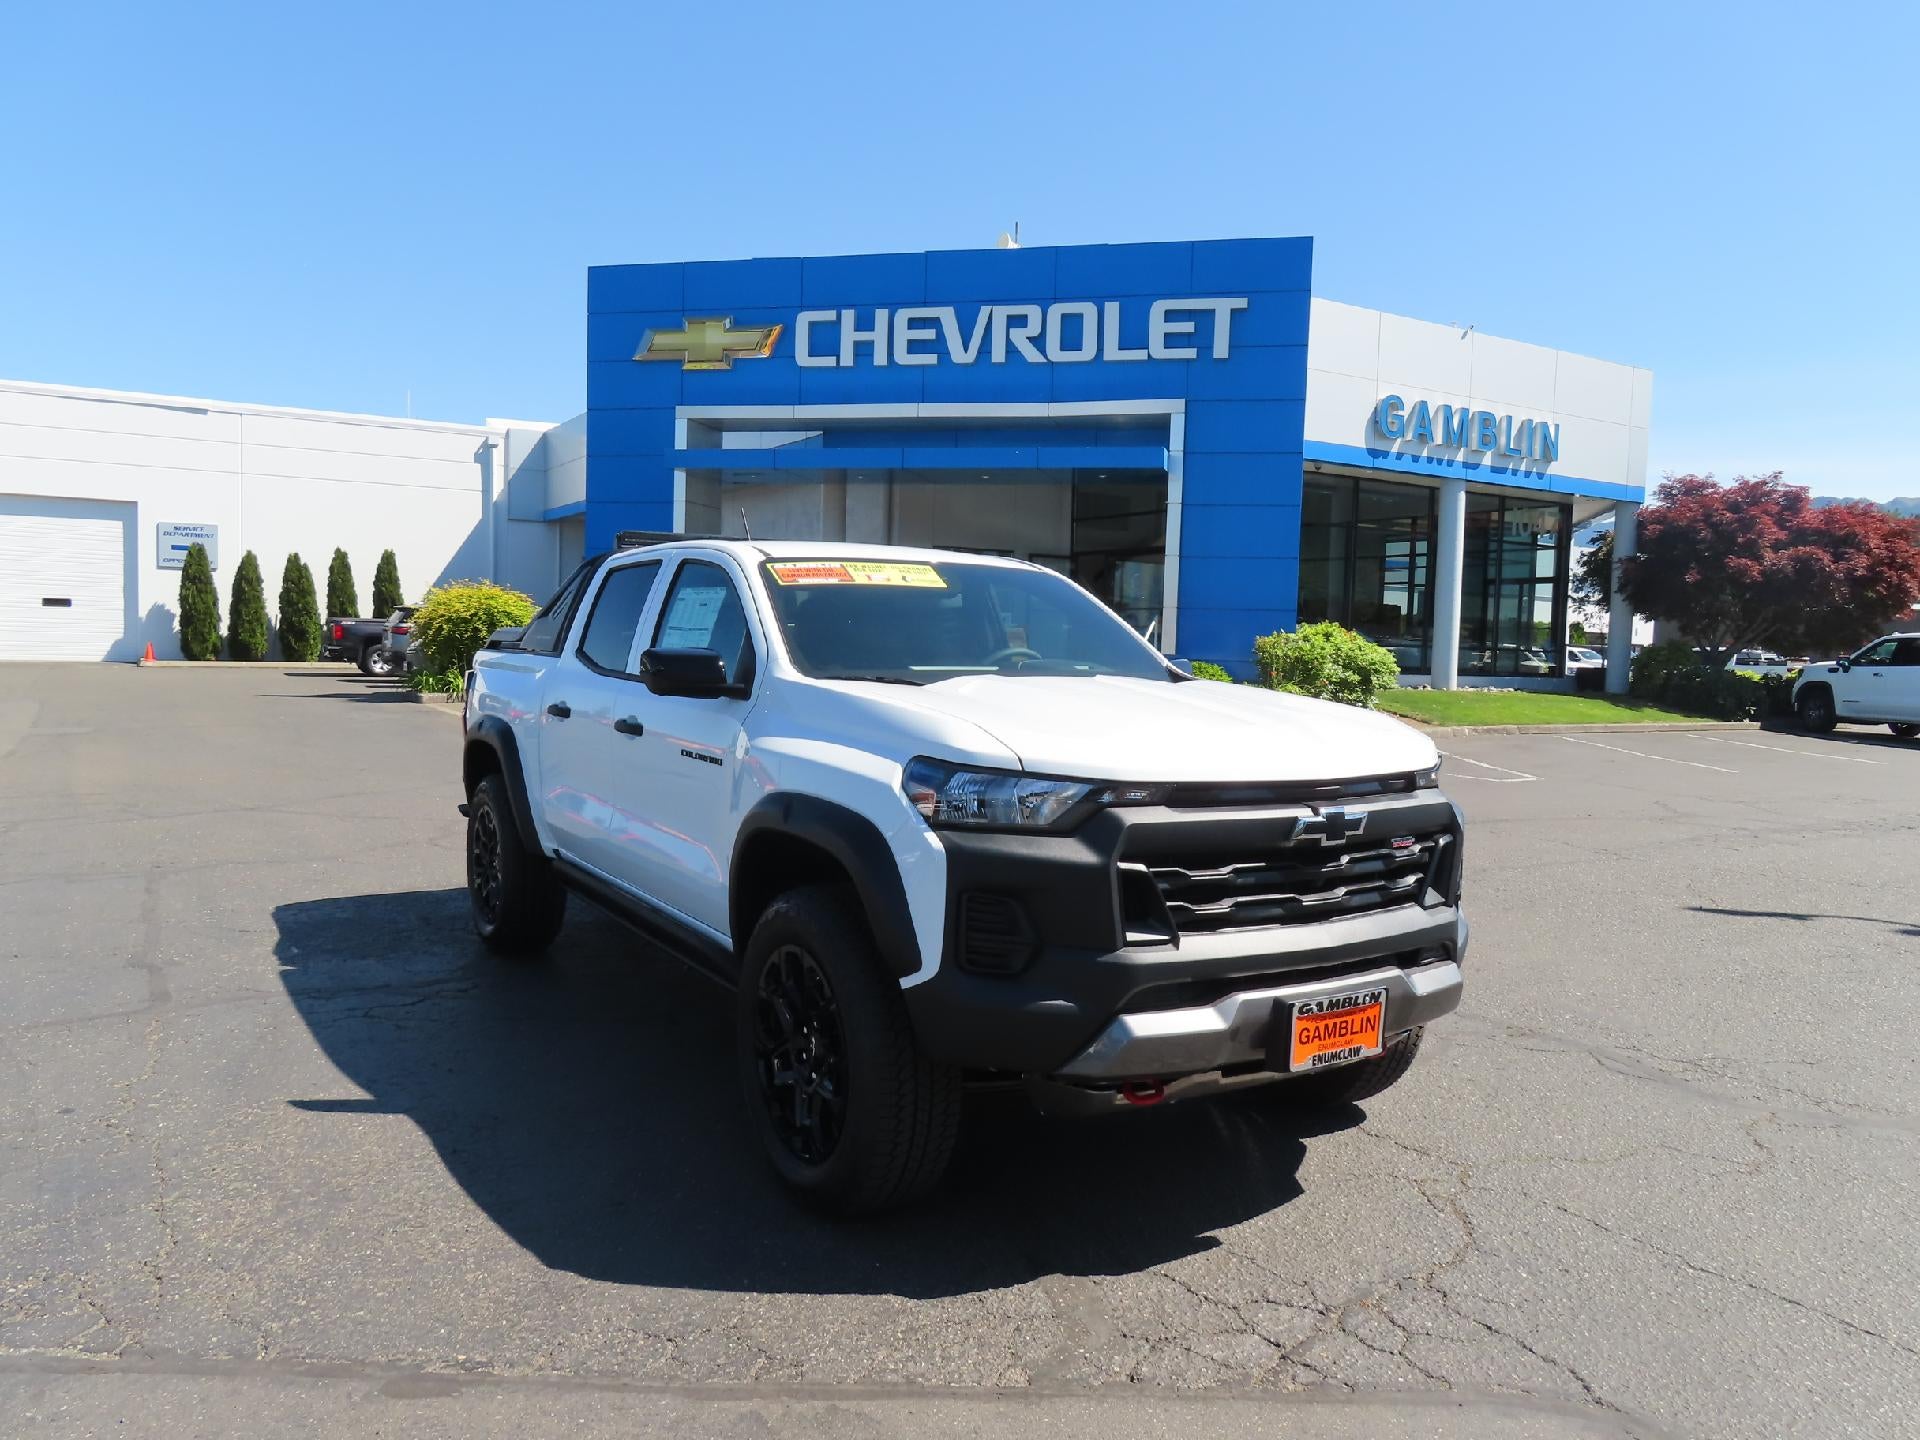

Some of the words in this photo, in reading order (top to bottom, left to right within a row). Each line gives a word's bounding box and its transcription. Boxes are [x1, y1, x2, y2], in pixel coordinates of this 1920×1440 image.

[795, 297, 1248, 367] CHEVROLET
[1376, 394, 1560, 462] GAMBLIN
[162, 531, 215, 539] DEPARTMENT
[1298, 1015, 1377, 1045] GAMBLIN
[1312, 1045, 1362, 1066] ENUMCLAW
